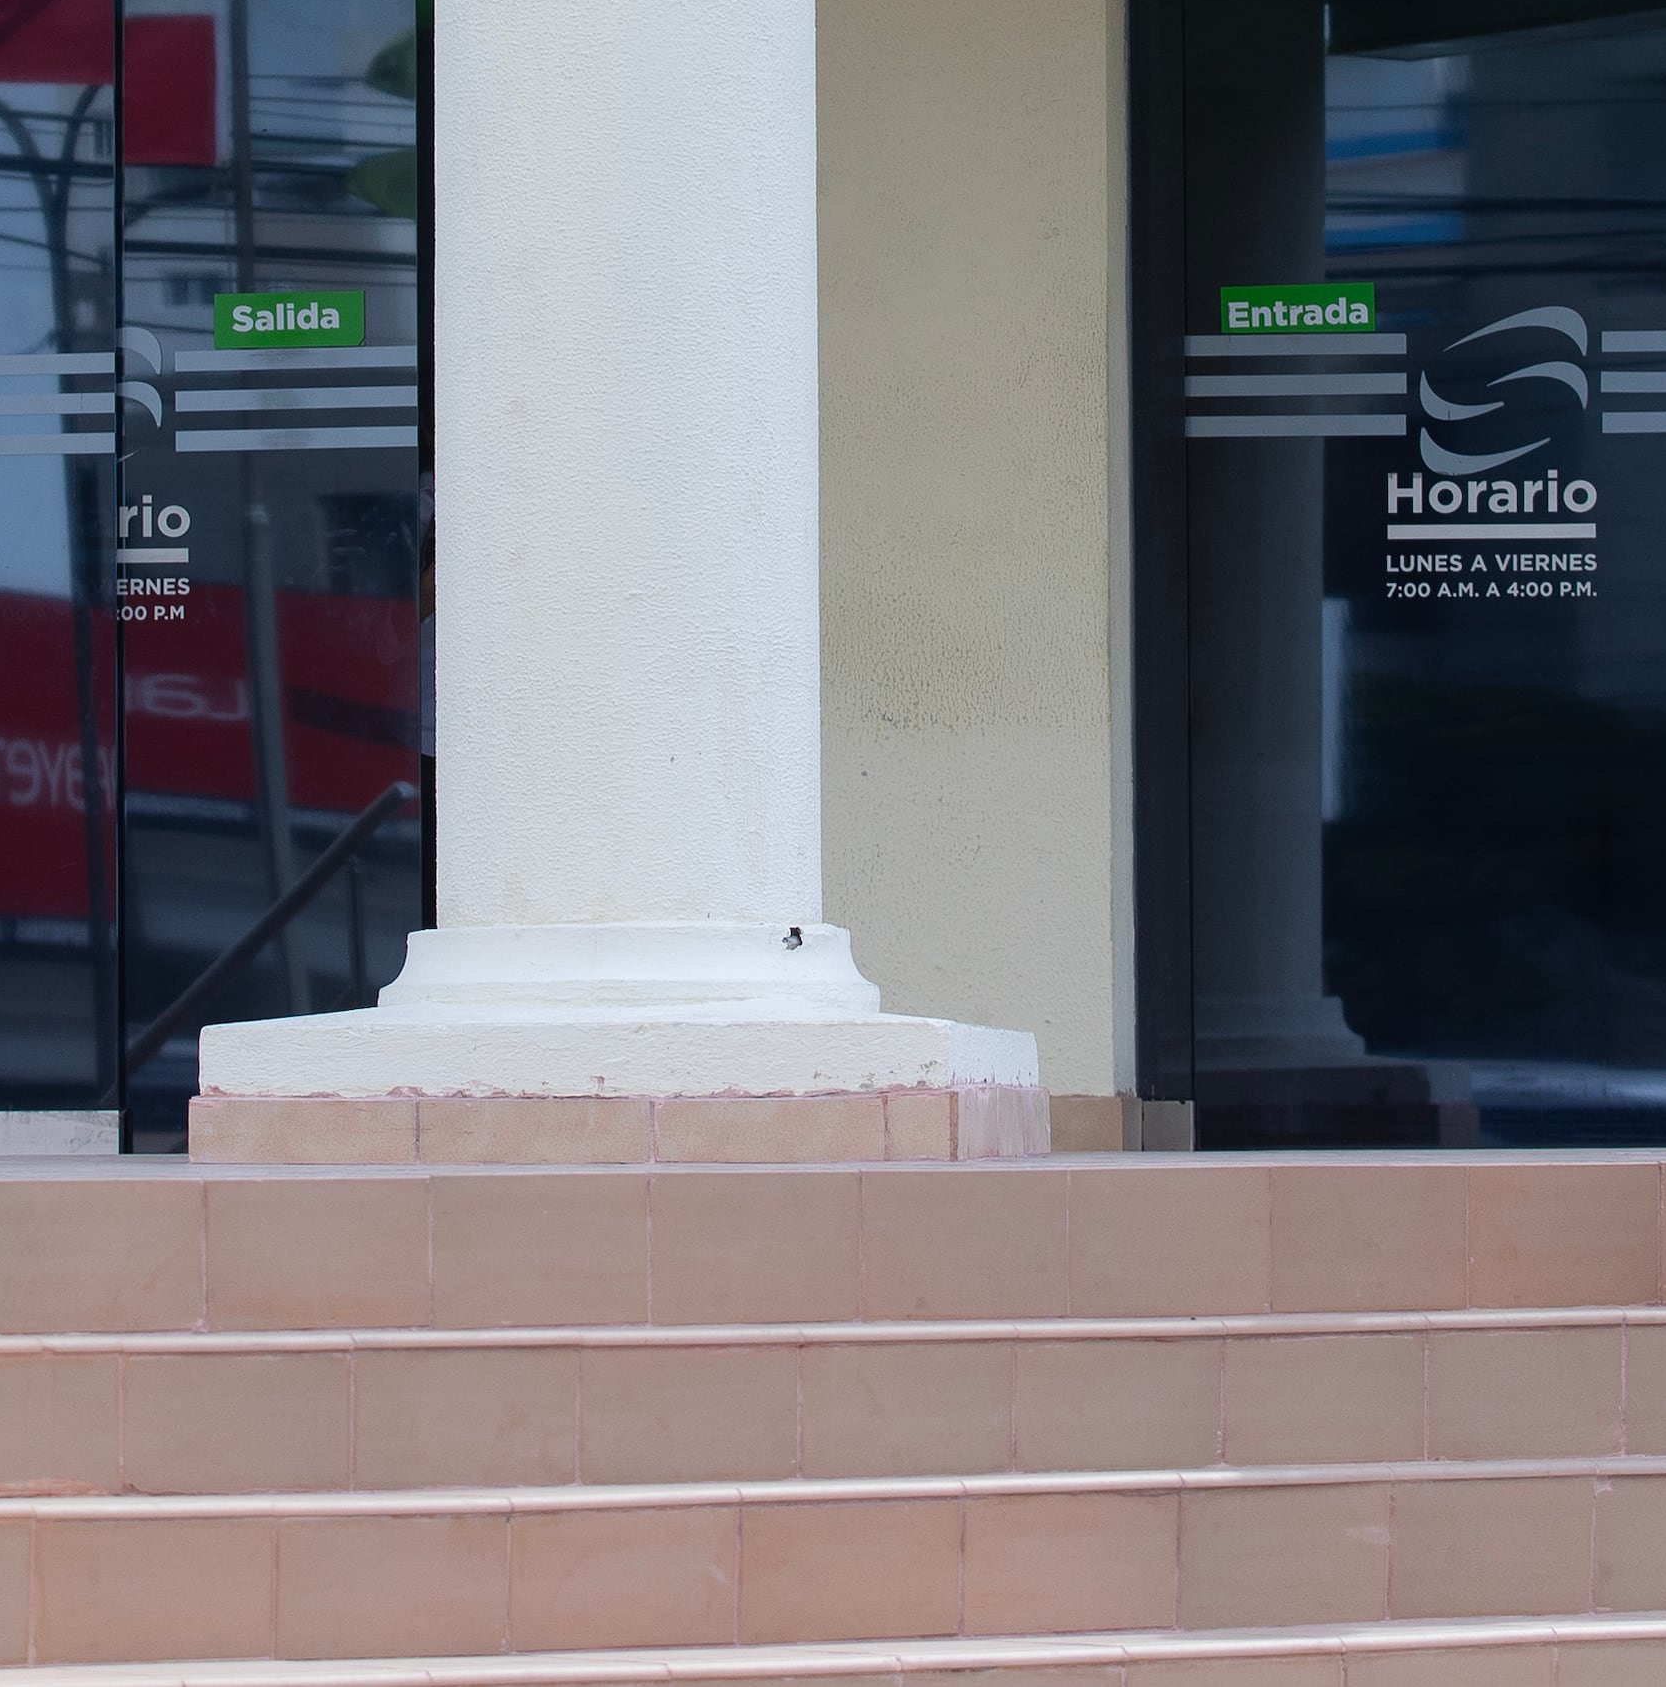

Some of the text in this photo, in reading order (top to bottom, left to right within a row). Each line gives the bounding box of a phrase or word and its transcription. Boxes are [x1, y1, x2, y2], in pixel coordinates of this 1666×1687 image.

[232, 302, 340, 332] Salida
[1228, 297, 1369, 328] Entrada
[1387, 469, 1598, 514] Horario
[1386, 553, 1598, 573] LUNES A VIERNES
[116, 578, 191, 596] ERNES
[1386, 581, 1598, 598] 7:00 A.M. A 4:00 P.M.
[116, 605, 147, 621] :00
